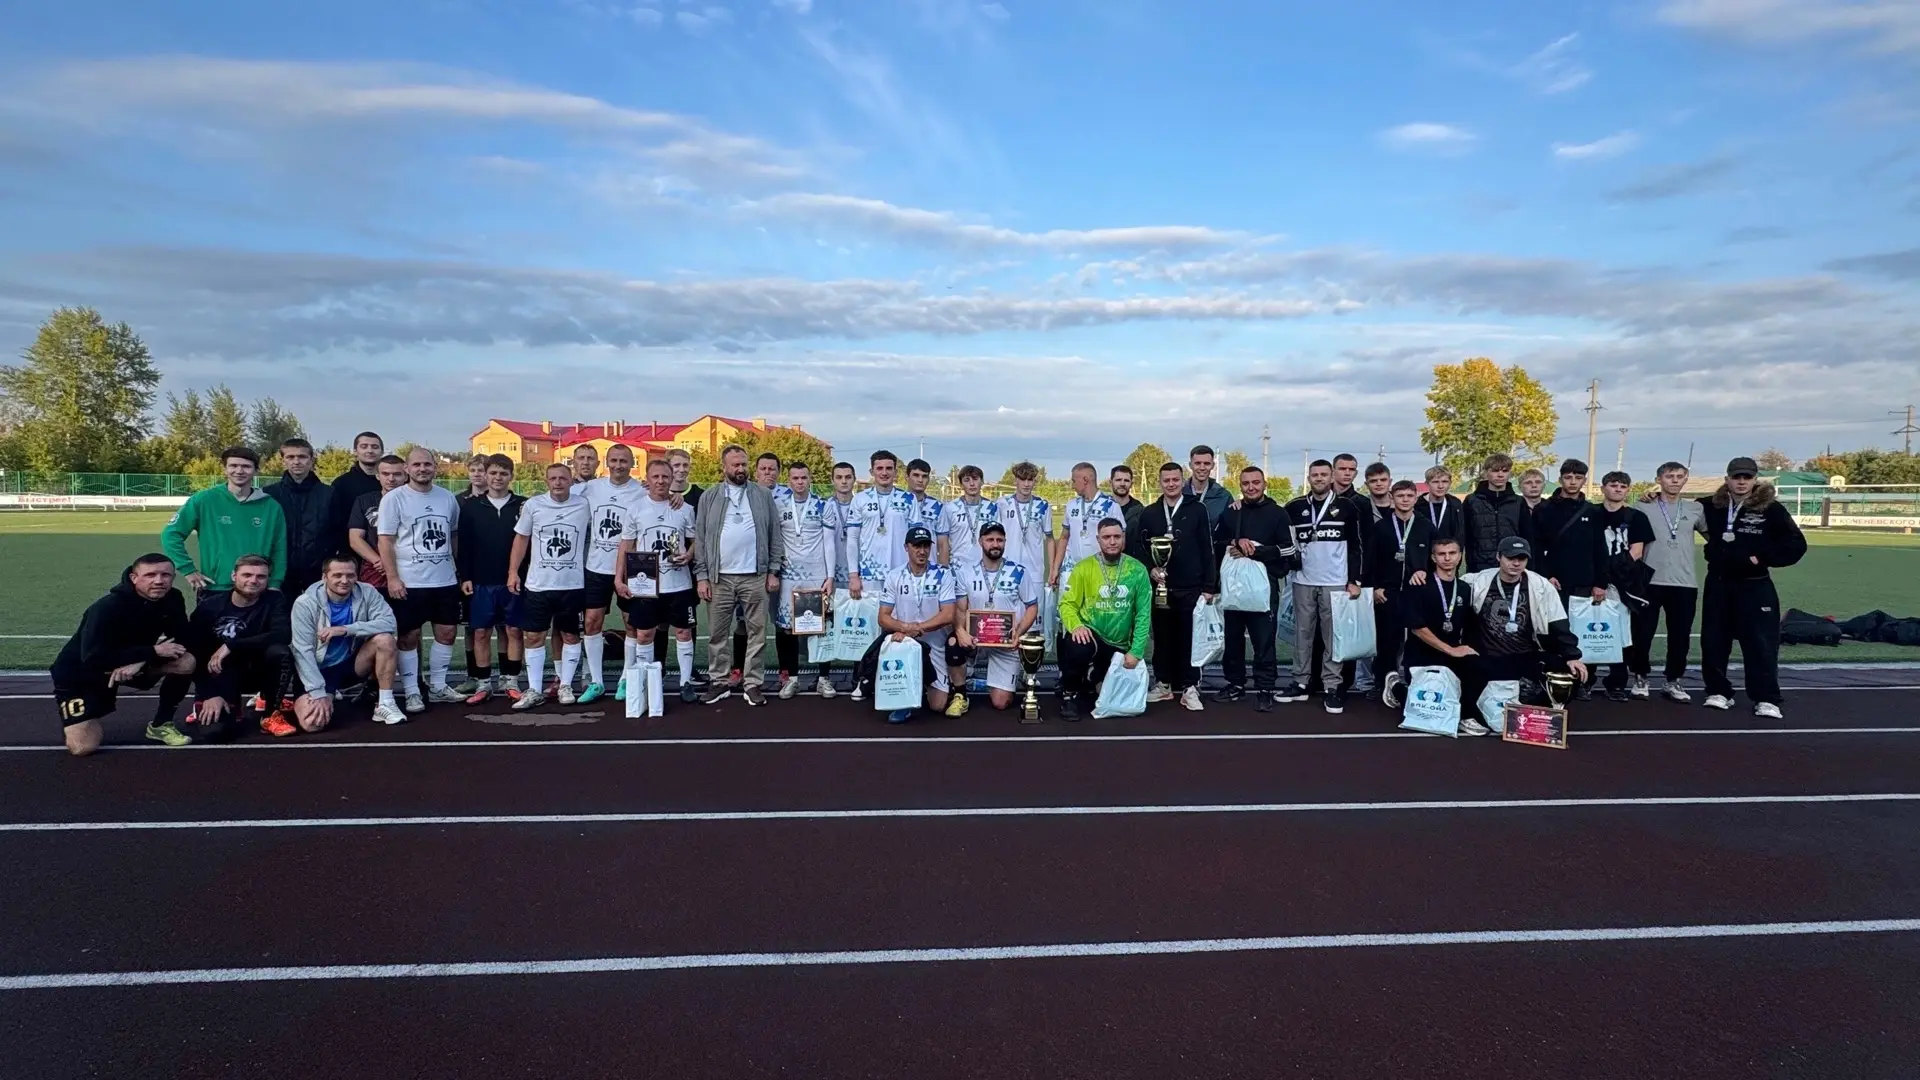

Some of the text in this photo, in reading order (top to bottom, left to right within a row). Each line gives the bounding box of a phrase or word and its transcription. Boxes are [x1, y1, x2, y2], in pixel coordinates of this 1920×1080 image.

[867, 502, 878, 511] 33
[783, 511, 793, 520] 88
[1006, 510, 1014, 518] 10
[1071, 508, 1079, 517] 99
[957, 513, 966, 522] 77
[1299, 529, 1341, 539] auentic
[900, 585, 909, 595] 13
[973, 580, 982, 591] 11
[1095, 600, 1131, 609] ВПКОЙЛ
[879, 671, 908, 681] ВПК-ОЙЛ
[60, 698, 86, 720] 10
[1410, 702, 1452, 711] ВПК-ОЙЛ
